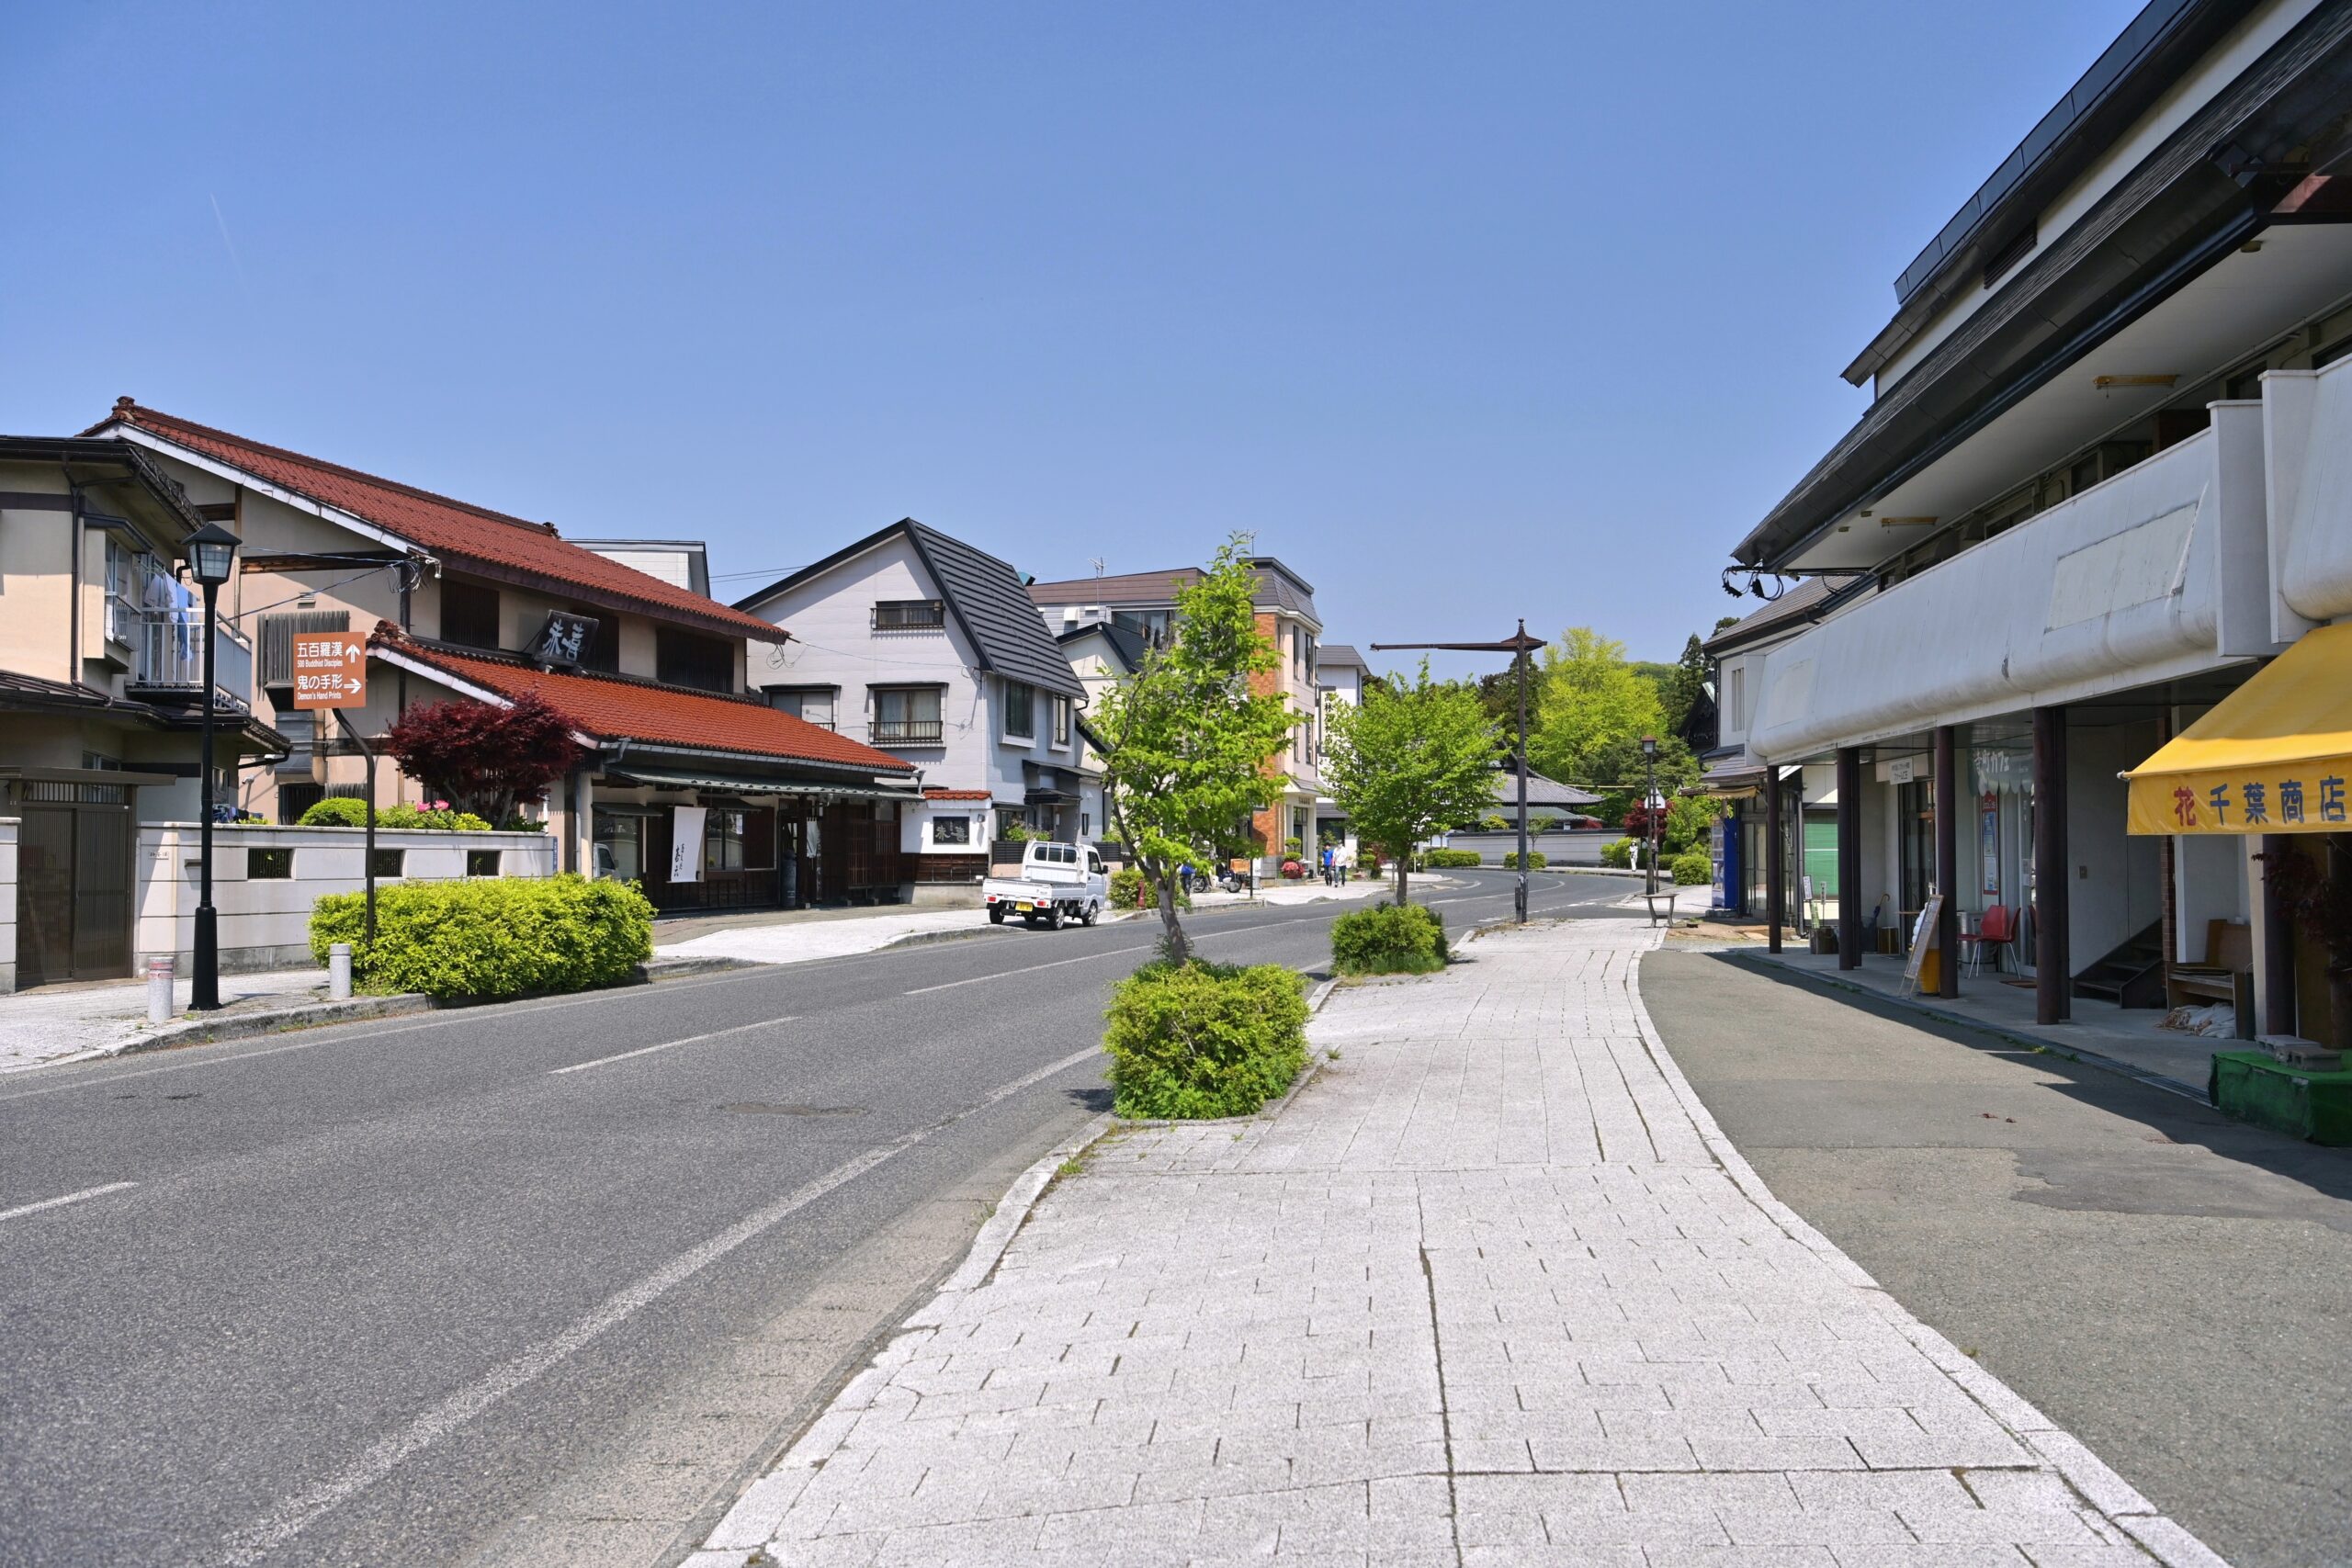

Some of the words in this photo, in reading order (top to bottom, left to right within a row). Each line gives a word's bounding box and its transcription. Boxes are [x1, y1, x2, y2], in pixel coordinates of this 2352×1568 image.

[297, 641, 344, 658] 五百羅漢
[305, 659, 324, 668] Buddhist
[323, 658, 344, 668] Disciples
[297, 673, 344, 690] 鬼の手形
[297, 691, 317, 700] Demon's
[316, 691, 329, 700] Hand
[328, 690, 343, 699] Prints
